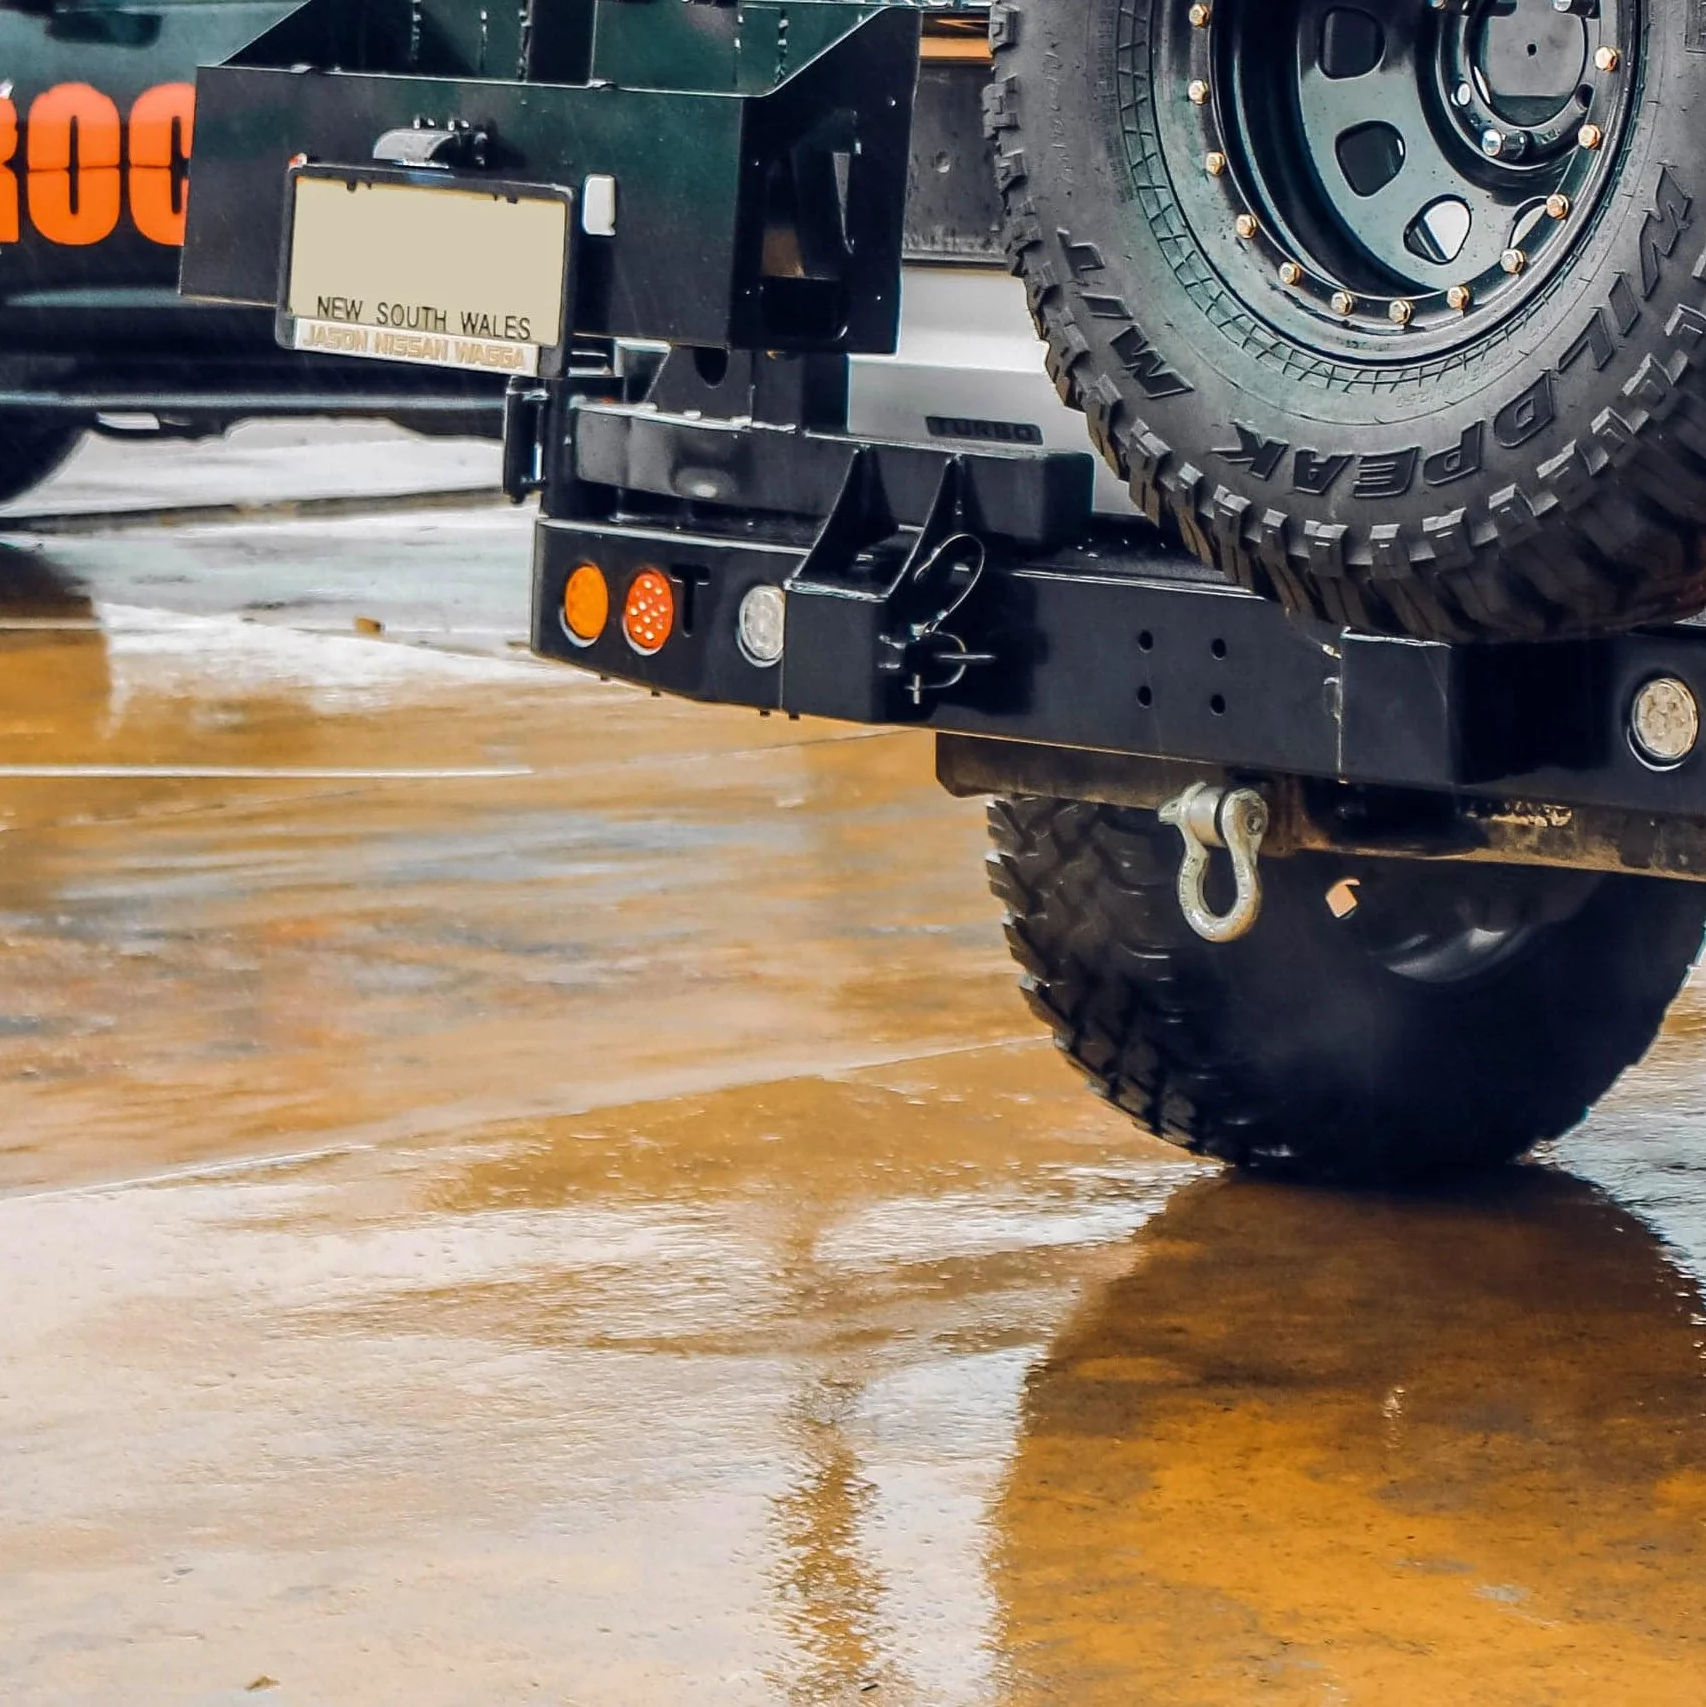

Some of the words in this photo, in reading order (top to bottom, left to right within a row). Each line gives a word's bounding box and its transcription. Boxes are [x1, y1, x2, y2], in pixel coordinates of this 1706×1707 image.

[0, 81, 197, 246] OC
[317, 295, 364, 321] NEW
[376, 301, 447, 332] SOUTH
[460, 309, 532, 341] WALES
[303, 324, 368, 350] JASON
[374, 331, 447, 361] NISSAN
[454, 340, 526, 369] WAGGA
[932, 417, 1038, 443] TURBO
